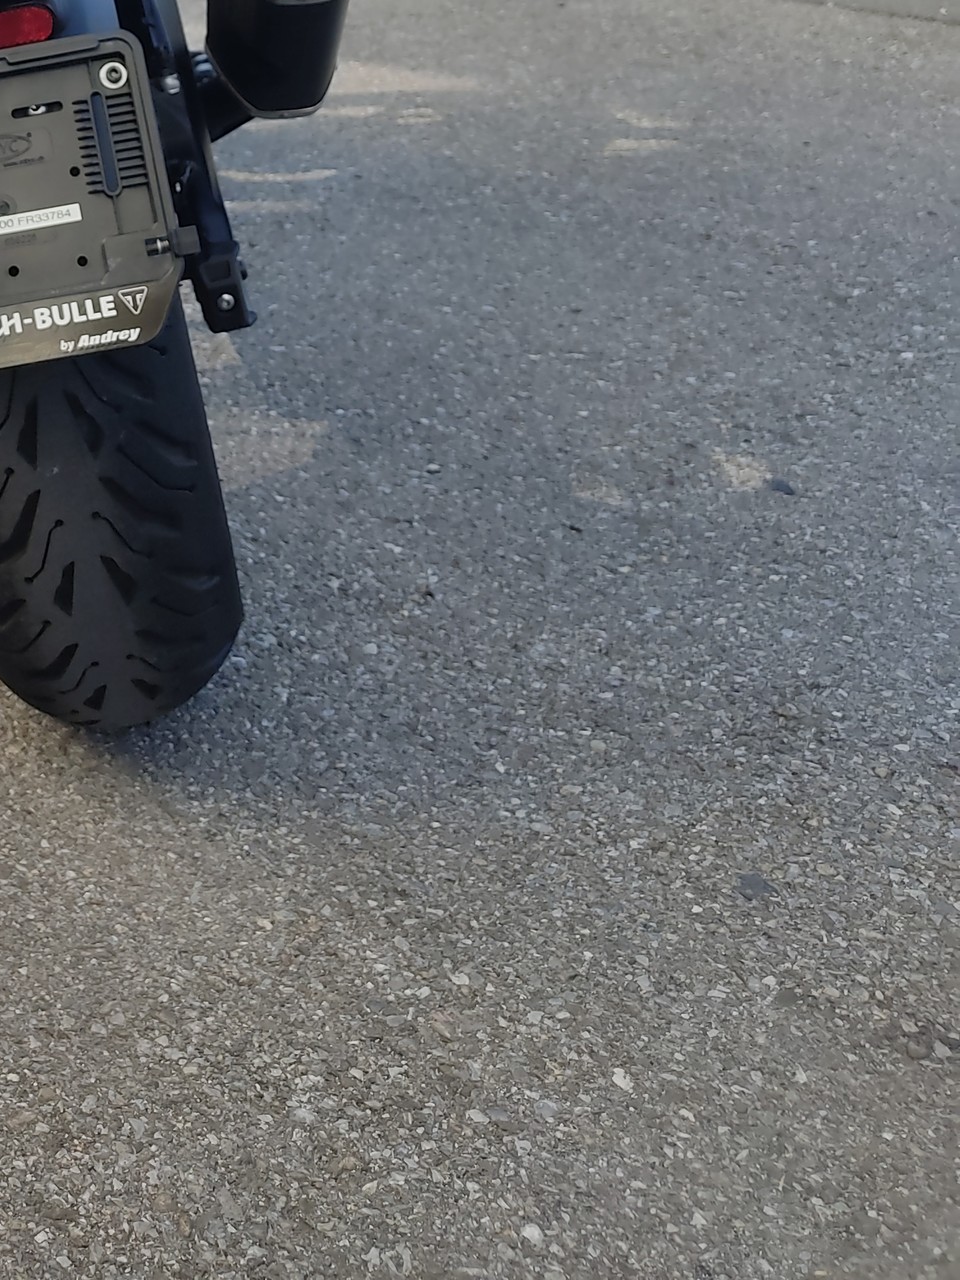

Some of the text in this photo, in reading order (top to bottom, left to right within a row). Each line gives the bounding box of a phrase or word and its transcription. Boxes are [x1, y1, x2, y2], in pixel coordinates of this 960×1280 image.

[17, 209, 72, 226] FR33784
[59, 327, 141, 353] by Andrey
